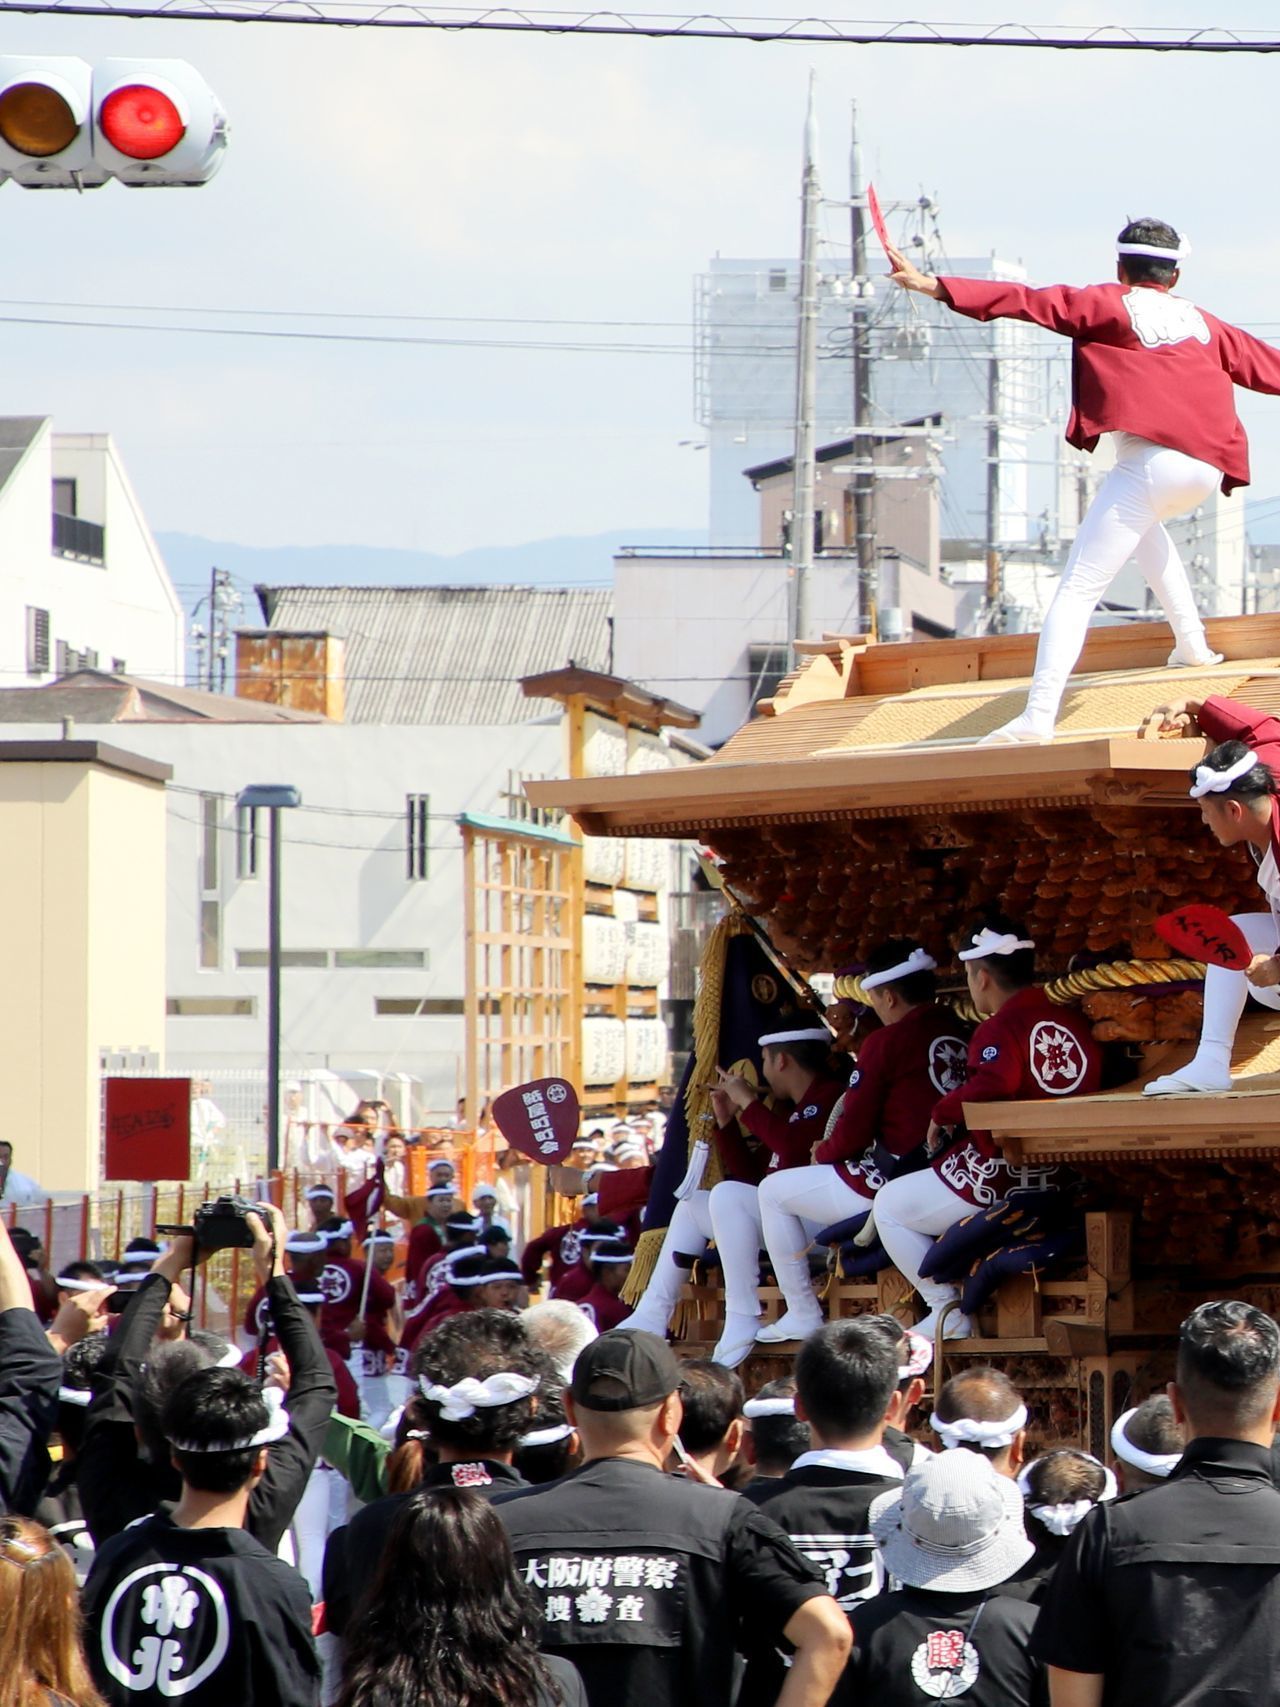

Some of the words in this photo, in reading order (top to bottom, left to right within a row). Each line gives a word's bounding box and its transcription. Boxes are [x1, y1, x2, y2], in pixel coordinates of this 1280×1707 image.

[1176, 915, 1237, 962] 大工方
[519, 1556, 679, 1590] 大阪府警察
